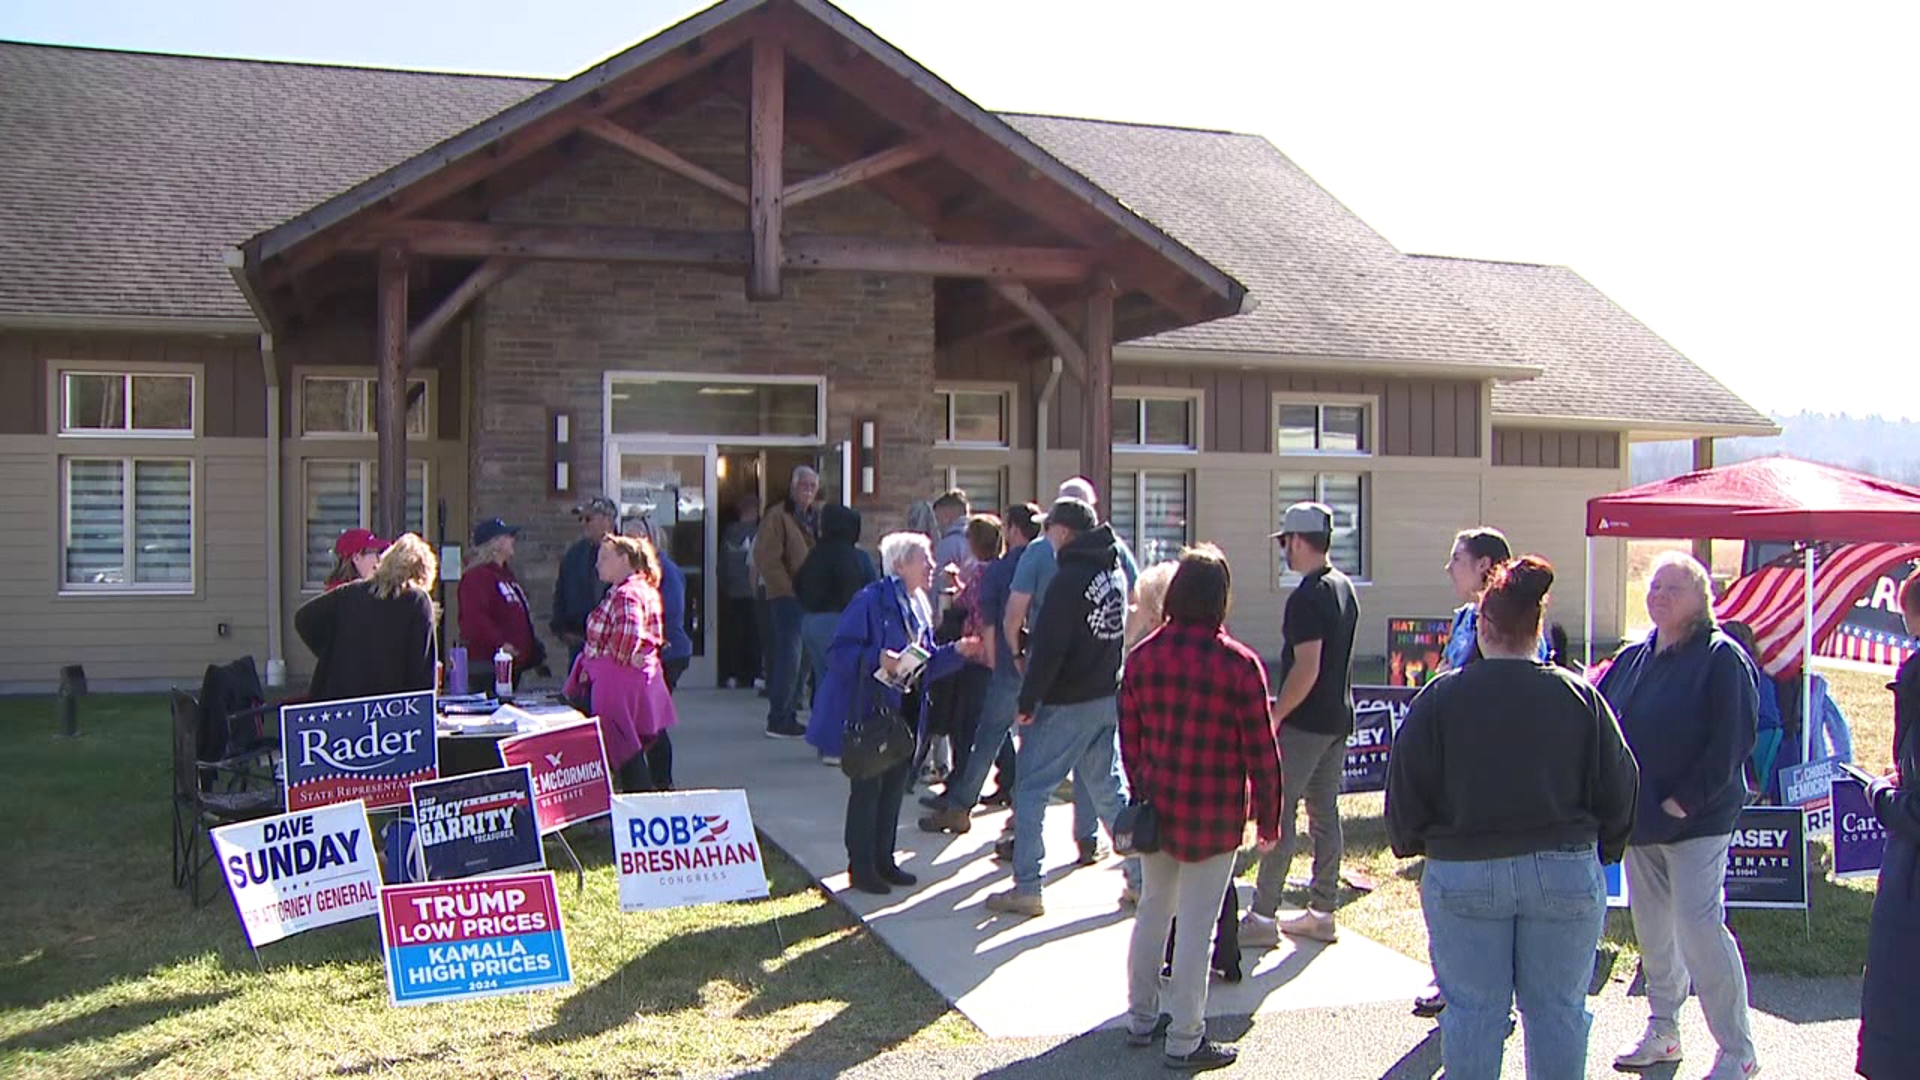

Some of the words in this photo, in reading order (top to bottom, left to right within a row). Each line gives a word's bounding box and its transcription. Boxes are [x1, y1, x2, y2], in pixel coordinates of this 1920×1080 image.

[1392, 620, 1421, 632] HATE
[1398, 633, 1432, 645] HOME
[363, 698, 420, 723] JACK
[298, 720, 422, 771] Rader
[300, 791, 335, 802] STATE
[419, 800, 463, 823] STACY
[264, 815, 314, 843] DAVE
[421, 806, 515, 847] GARRITY
[628, 815, 691, 848] ROB
[1731, 828, 1788, 848] ASEY
[1842, 830, 1887, 842] CONGR
[228, 828, 361, 889] SUNDAY
[621, 842, 757, 875] BRESNAHAN
[660, 871, 727, 885] CONGRESS
[316, 880, 377, 912] GENERAL
[412, 889, 526, 920] TRUMP
[399, 920, 455, 943] LOW
[462, 912, 546, 937] PRICES
[429, 939, 527, 965] KAMALA
[408, 963, 465, 985] HIGH
[471, 954, 551, 978] PRICES
[469, 979, 498, 991] 2024
